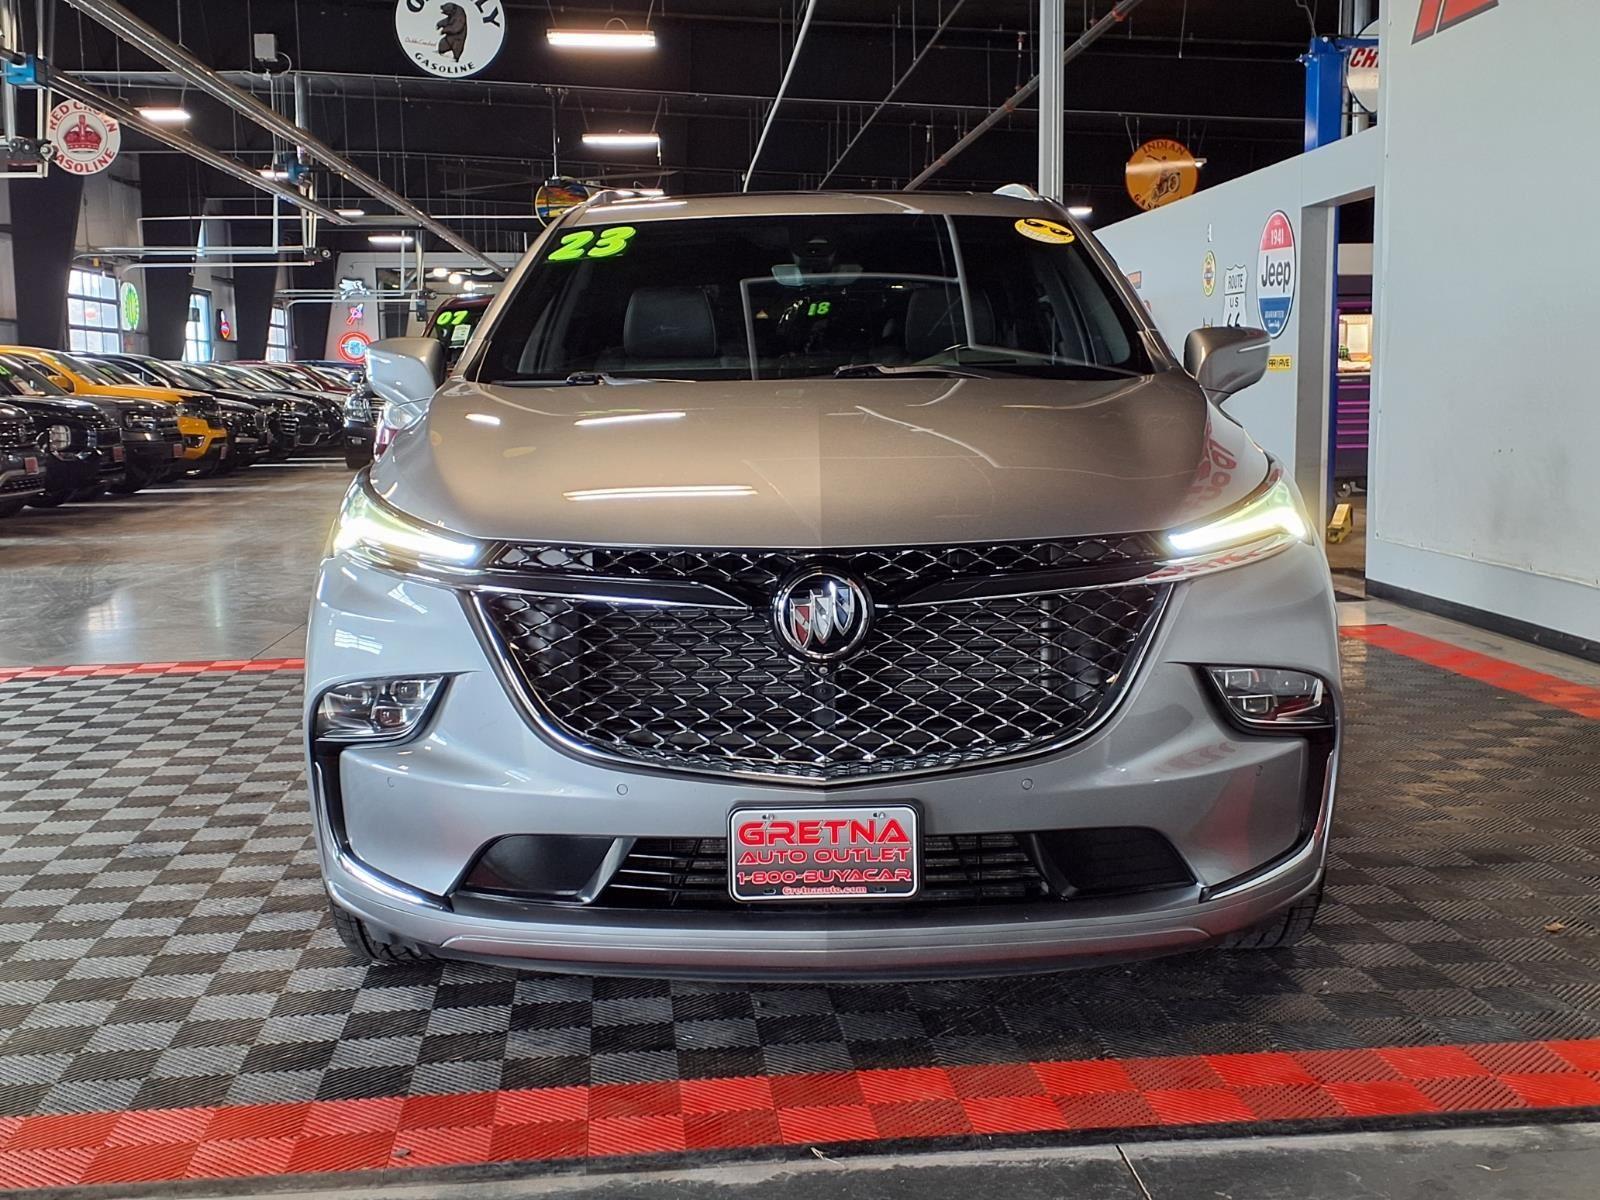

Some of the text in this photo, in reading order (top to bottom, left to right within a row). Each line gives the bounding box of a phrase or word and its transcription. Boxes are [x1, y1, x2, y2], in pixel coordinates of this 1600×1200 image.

[415, 52, 475, 73] GASOLINE
[1143, 141, 1186, 155] INDIAN
[548, 226, 637, 260] 23
[1271, 227, 1284, 246] 1941
[1228, 273, 1243, 290] ROUTE
[1261, 256, 1291, 293] Jeep
[738, 819, 912, 846] GRETNA
[738, 847, 912, 866] AUTO OUTLET
[737, 868, 912, 885] 1-800-BUYACAR
[782, 886, 867, 895] Gretnaauto.com
